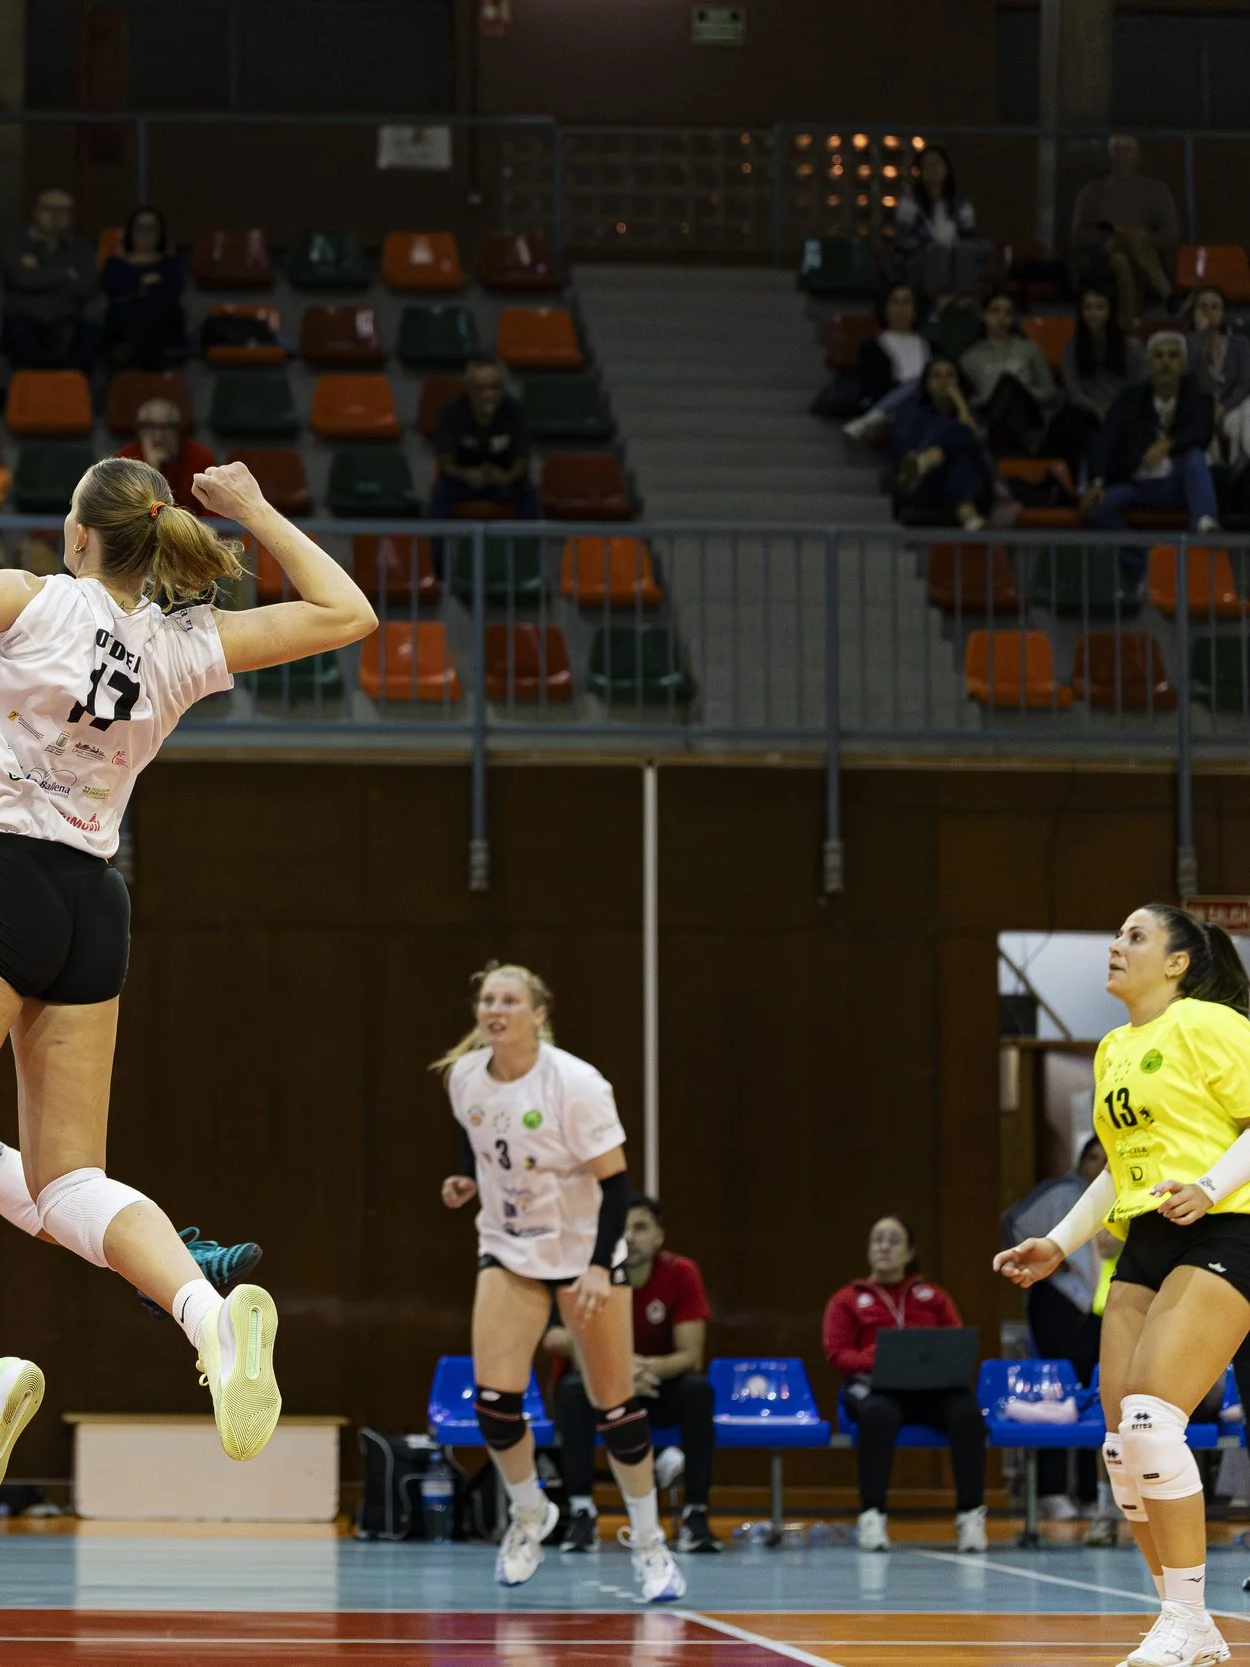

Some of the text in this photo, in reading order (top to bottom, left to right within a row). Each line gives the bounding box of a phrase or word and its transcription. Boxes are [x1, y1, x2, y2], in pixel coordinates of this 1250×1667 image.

[67, 662, 140, 732] 17
[40, 780, 71, 794] Ballena
[1104, 1087, 1138, 1129] 13
[495, 1139, 512, 1170] 3
